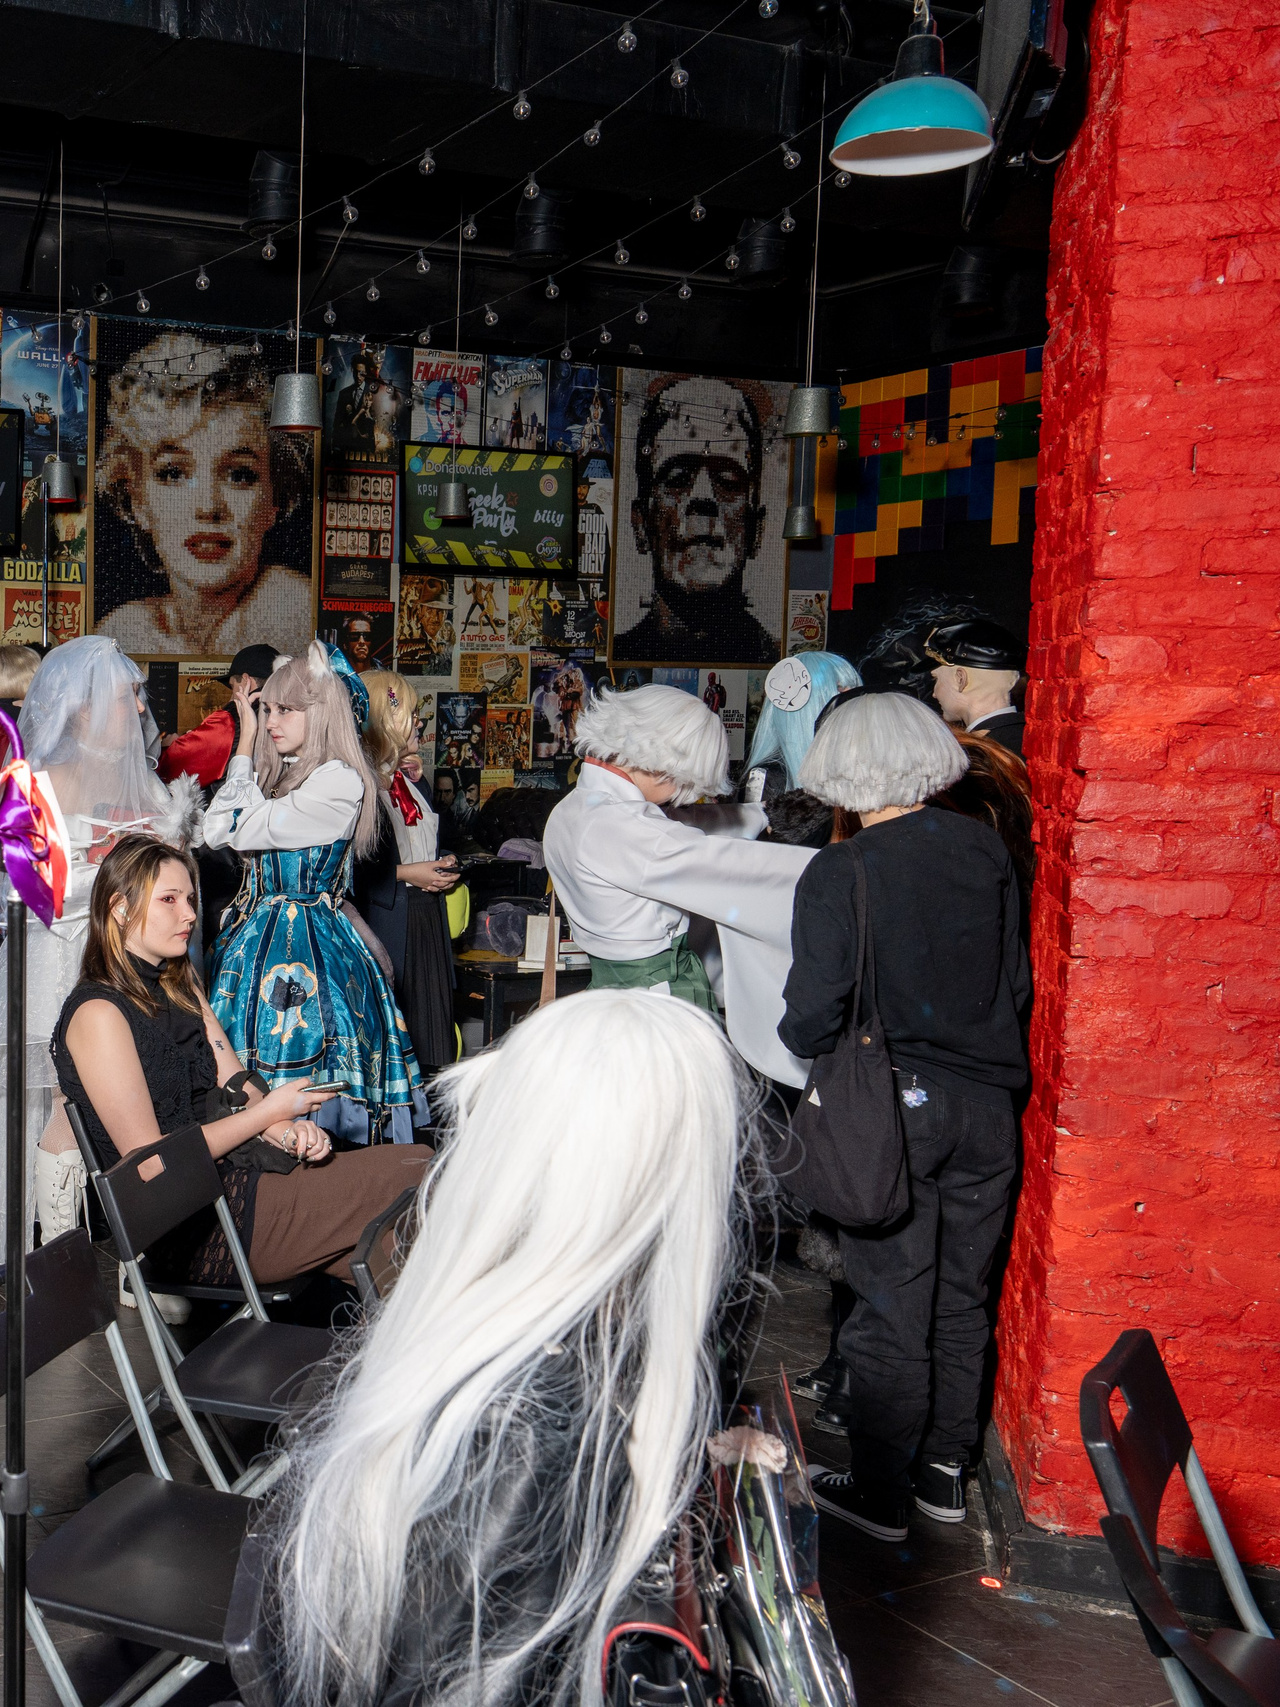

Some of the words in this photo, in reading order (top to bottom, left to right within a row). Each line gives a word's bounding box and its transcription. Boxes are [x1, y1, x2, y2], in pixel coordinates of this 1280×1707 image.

[414, 361, 452, 383] FIGHT
[450, 363, 481, 385] CLUB
[491, 369, 543, 396] SUPERMAN
[425, 459, 493, 476] Donatov.net
[587, 458, 608, 468] STAR
[581, 467, 613, 479] WARS
[417, 483, 439, 497] KPSH
[471, 501, 519, 538] Party
[533, 509, 565, 528] billy
[578, 513, 607, 534] GOOD
[584, 533, 607, 554] BAD
[3, 559, 82, 583] GODZILLA
[581, 553, 606, 574] UGLY
[340, 569, 375, 580] BUDAPEST
[12, 599, 76, 615] MICKEY
[321, 600, 394, 613] SCHWARZENEGGER
[565, 609, 576, 621] 12
[460, 634, 466, 642] A
[466, 634, 487, 642] TUTTO
[488, 634, 506, 642] GAS
[564, 631, 587, 639] MOON
